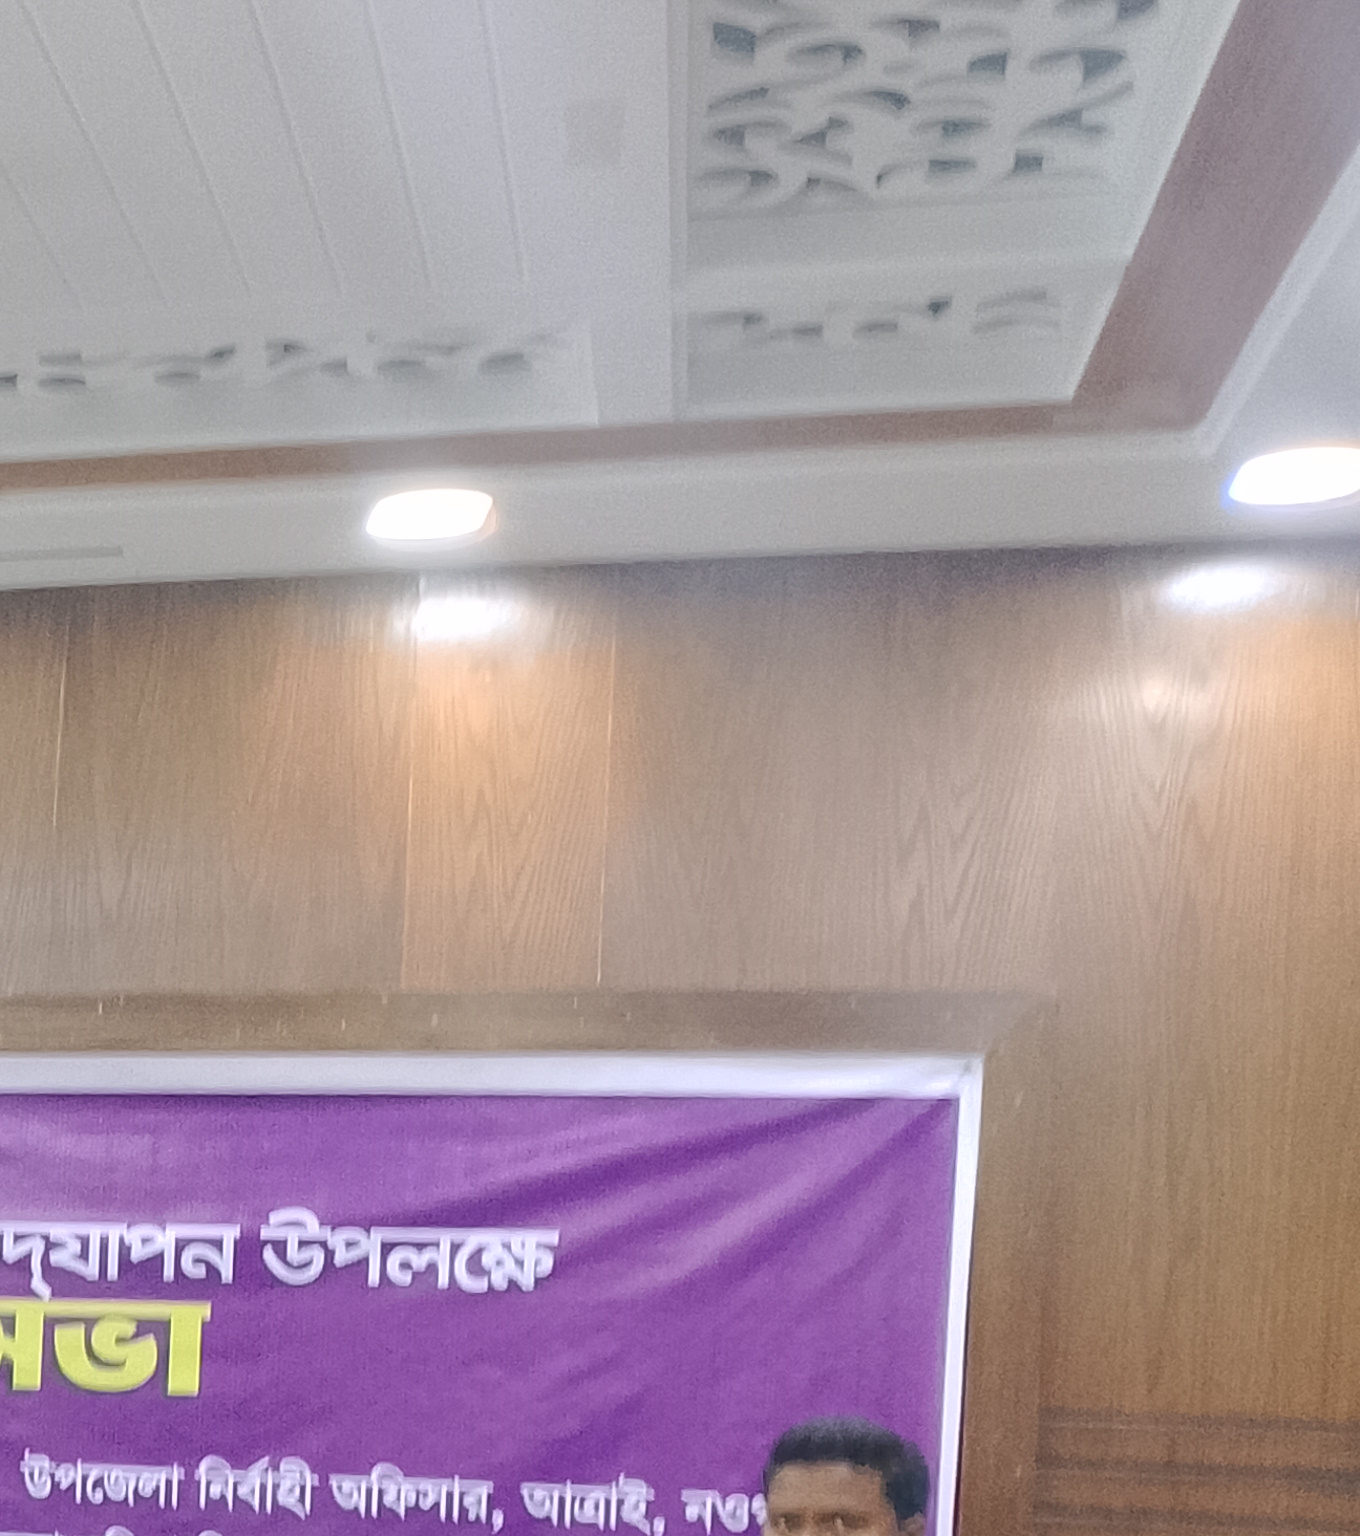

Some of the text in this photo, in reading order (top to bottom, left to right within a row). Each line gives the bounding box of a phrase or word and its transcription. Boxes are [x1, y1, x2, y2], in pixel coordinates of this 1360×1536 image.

[260, 1205, 560, 1293] উপলক্ষে
[19, 1447, 185, 1511] উপজেলা
[195, 1454, 320, 1522] নির্বাহী
